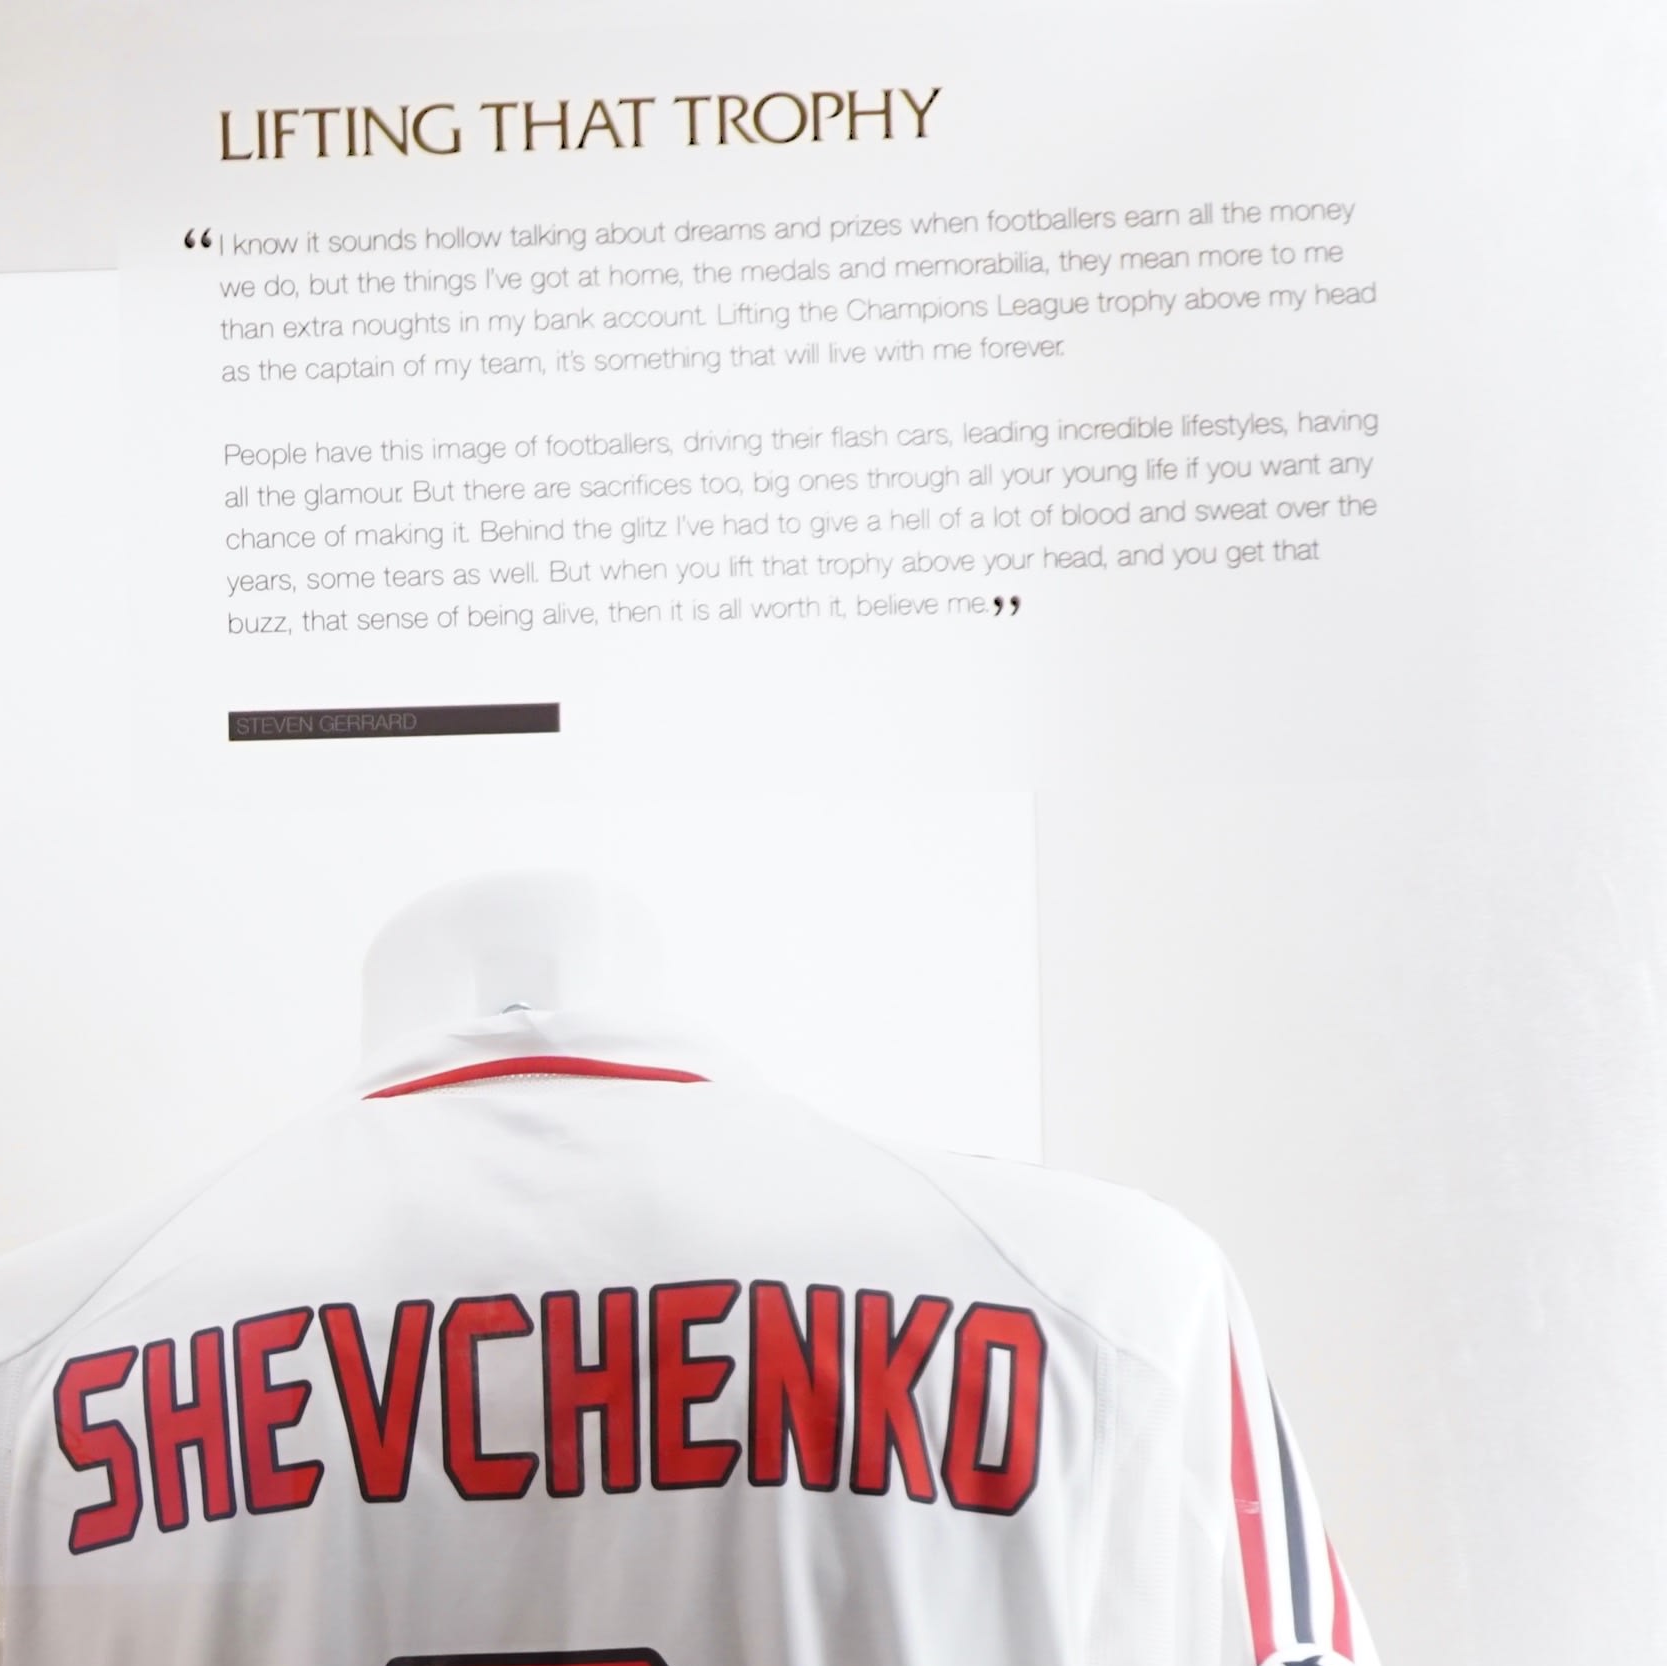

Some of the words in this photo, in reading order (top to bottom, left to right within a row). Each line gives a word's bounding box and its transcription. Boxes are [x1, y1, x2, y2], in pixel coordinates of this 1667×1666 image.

[220, 102, 462, 162] LIFTING
[479, 96, 656, 153] THAT
[673, 87, 942, 147] TROPHY
[232, 232, 299, 257] know
[306, 230, 321, 254] it
[327, 227, 418, 254] sounds
[424, 225, 503, 251] hollow
[508, 223, 587, 253] talking
[594, 221, 667, 246] about
[673, 219, 767, 244] dreams
[773, 215, 822, 241] and
[829, 213, 903, 244] prizes
[909, 211, 979, 235] when
[986, 206, 1118, 233] footballers
[1123, 208, 1181, 229] earn
[1187, 201, 1214, 227] all
[1220, 200, 1263, 225] the
[1269, 202, 1356, 227] money
[236, 715, 314, 736] STEVEN
[319, 712, 418, 734] GERRARD
[52, 1278, 1048, 1555] SHEVCHENKO
